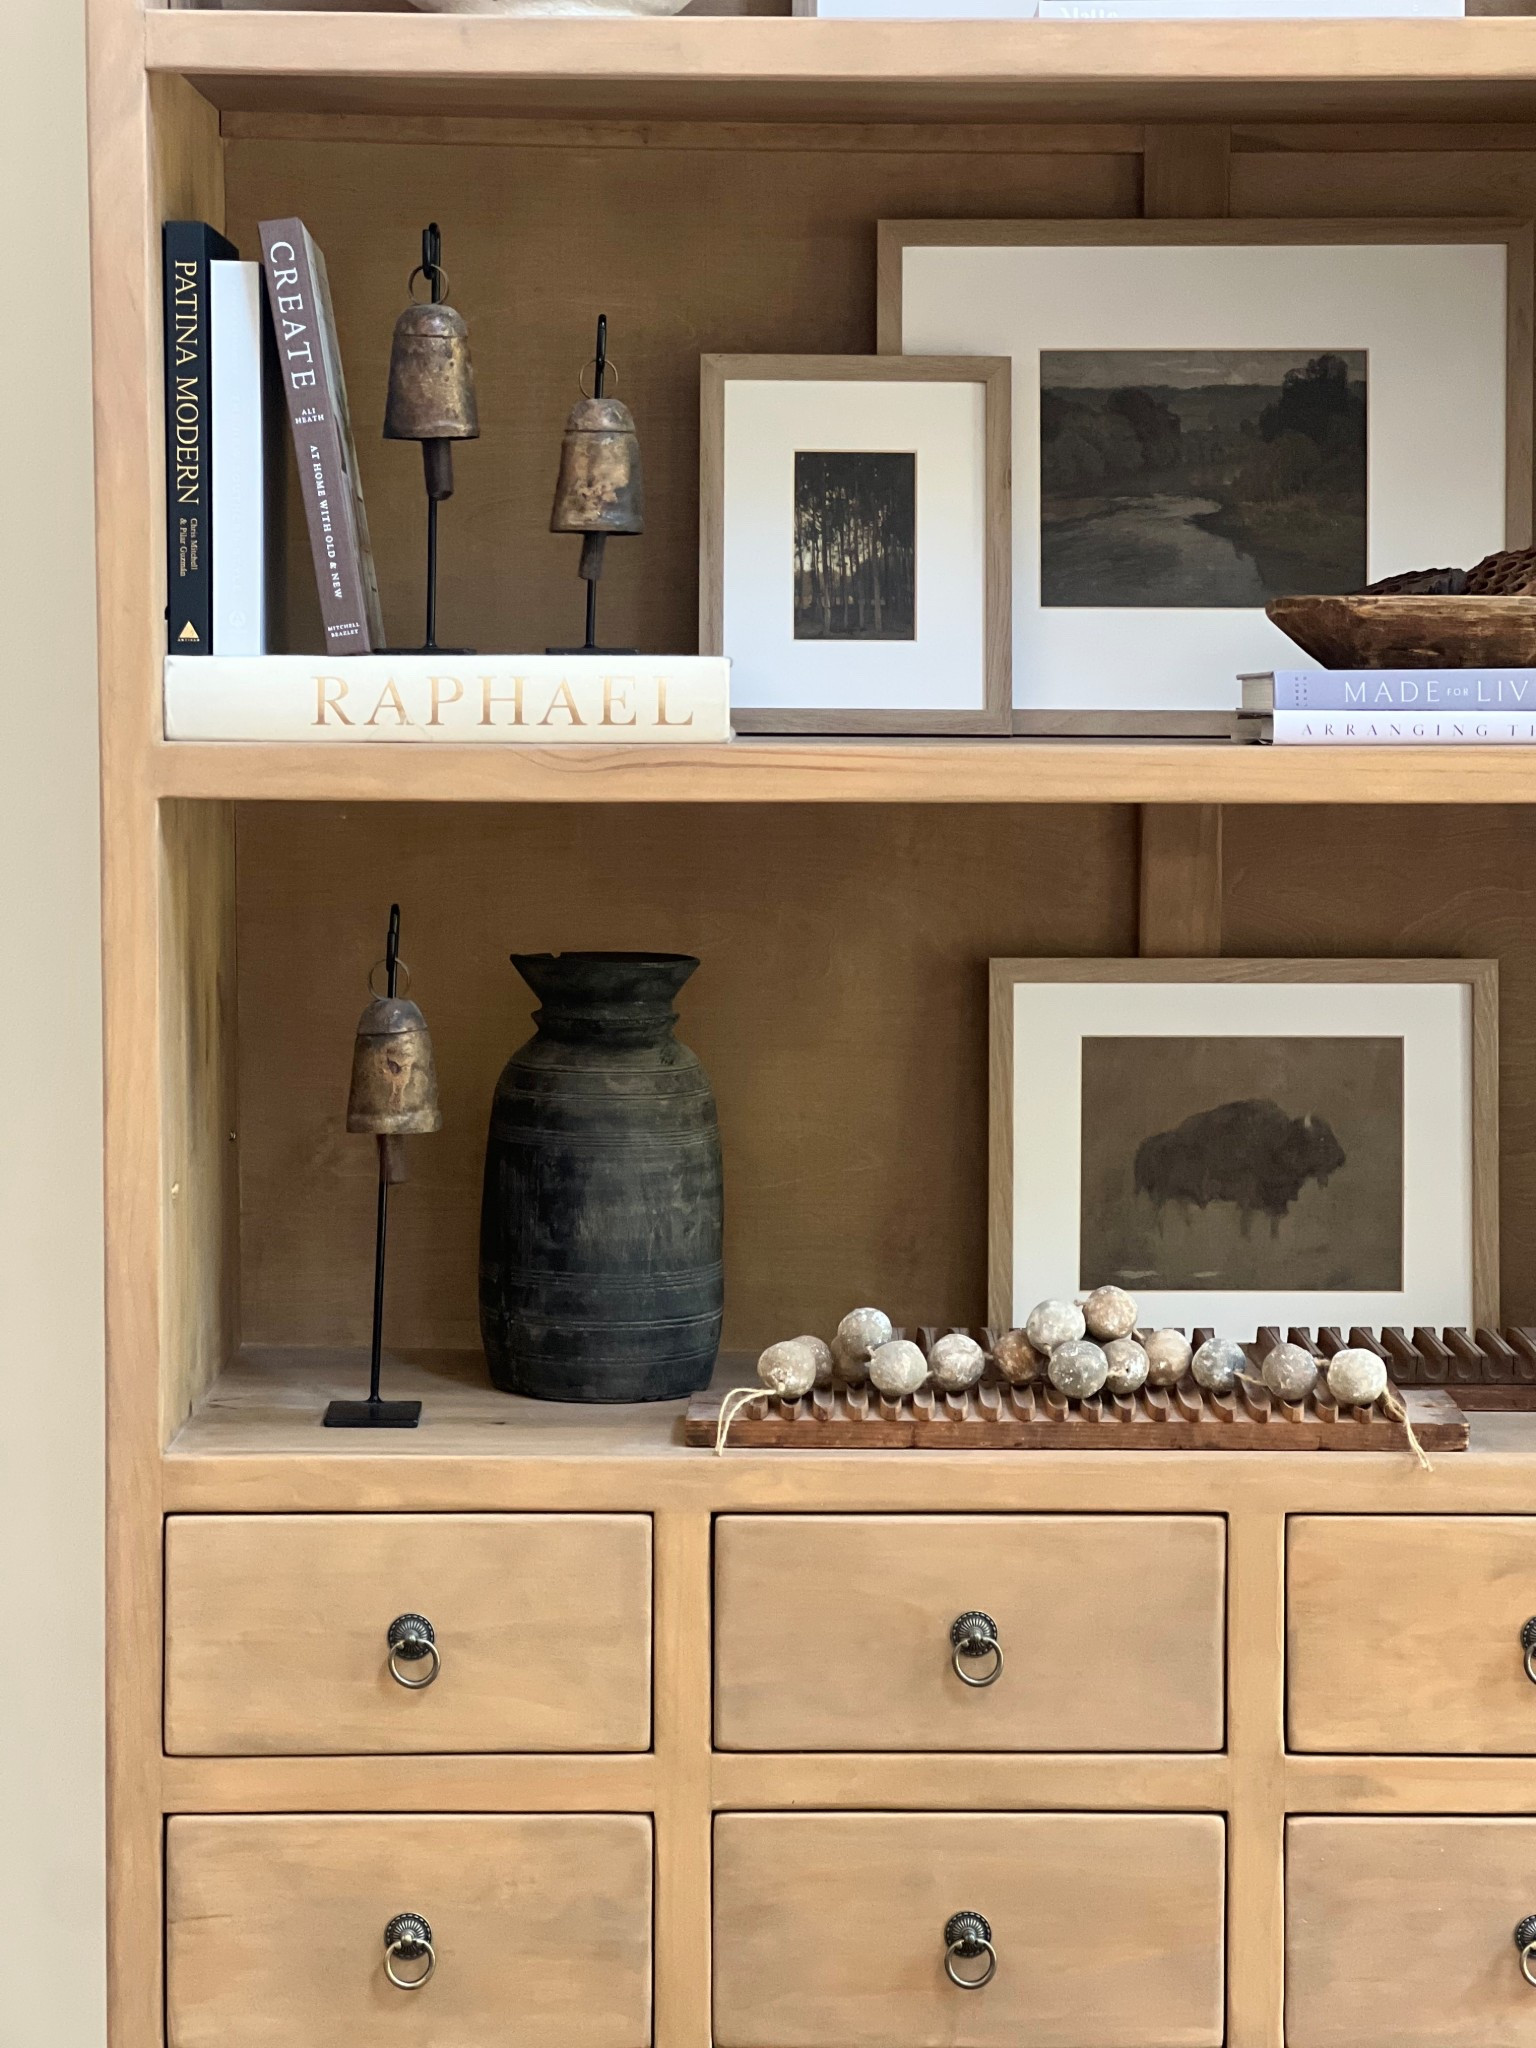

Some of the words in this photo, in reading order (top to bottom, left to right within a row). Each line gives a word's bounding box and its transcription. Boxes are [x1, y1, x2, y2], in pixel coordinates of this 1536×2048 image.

[174, 260, 198, 366] PATINA
[270, 241, 316, 389] CREATE
[295, 413, 325, 425] HEATH
[301, 407, 316, 416] ALI
[175, 376, 199, 505] MODERN
[309, 445, 320, 460] AT
[312, 463, 326, 496] HOME
[319, 499, 332, 532] WITH
[179, 527, 188, 544] Pilar
[190, 518, 199, 538] Chris
[190, 540, 199, 570] Mitchell
[325, 535, 336, 558] OLD
[329, 561, 337, 570] &
[331, 573, 343, 598] NEW
[327, 622, 361, 632] MITCHELL
[330, 629, 360, 638] BEAZLEY
[310, 675, 694, 726] RAPHAEL
[1344, 680, 1441, 703] MADE
[1446, 686, 1469, 697] FOR
[1476, 680, 1529, 703] LIV
[1302, 723, 1488, 737] ARRANGING
